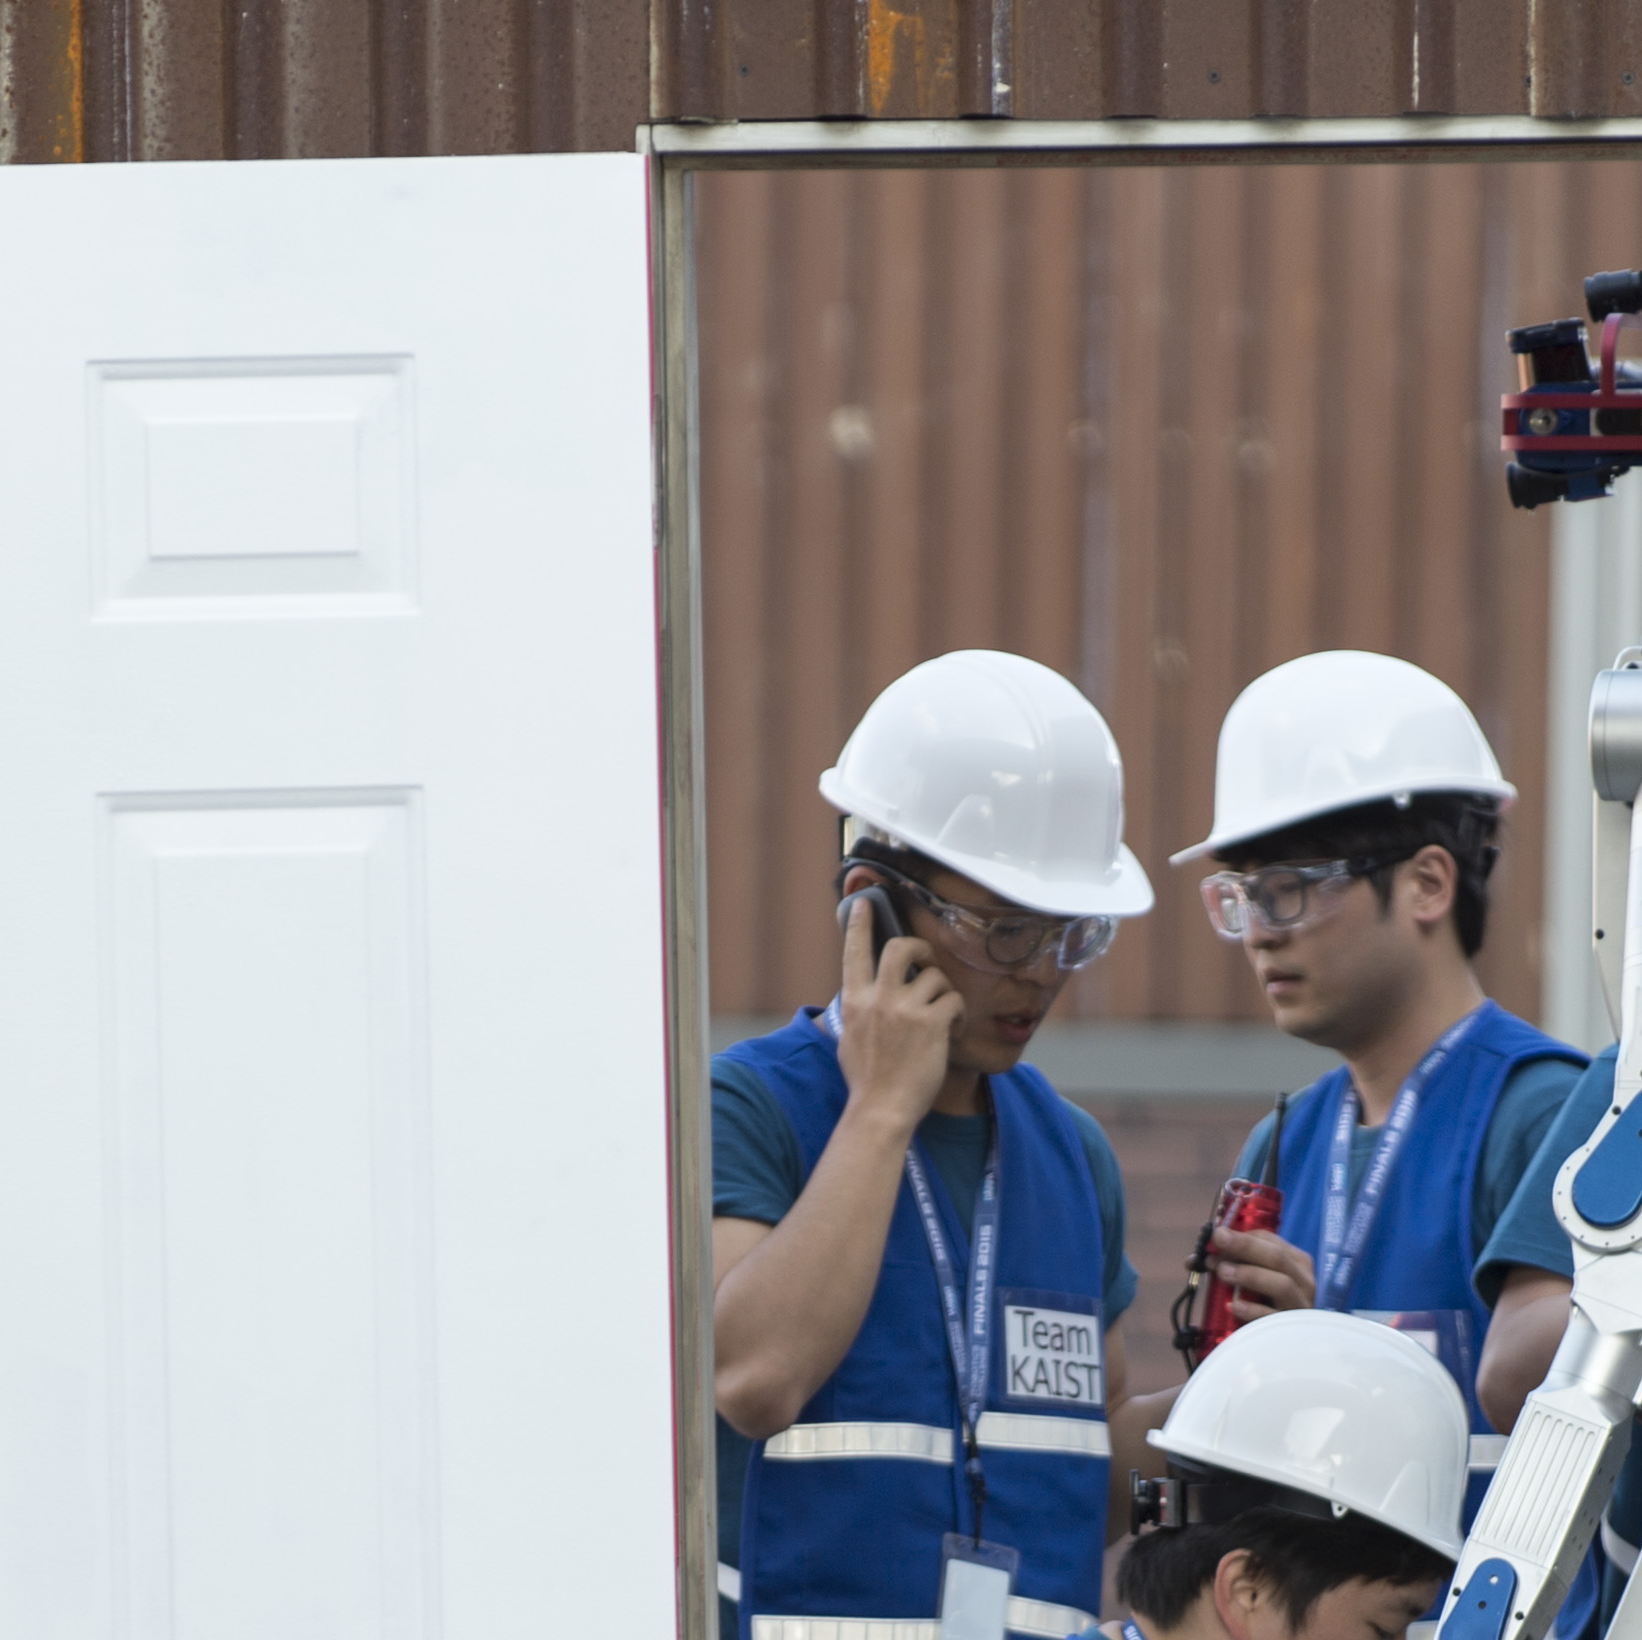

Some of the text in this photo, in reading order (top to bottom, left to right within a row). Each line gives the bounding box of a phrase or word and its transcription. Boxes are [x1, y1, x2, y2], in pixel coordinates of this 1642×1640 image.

[977, 1224, 992, 1267] 2015
[973, 1269, 989, 1335] FINALS
[1013, 1309, 1093, 1356] Team
[1012, 1354, 1101, 1400] KAIST
